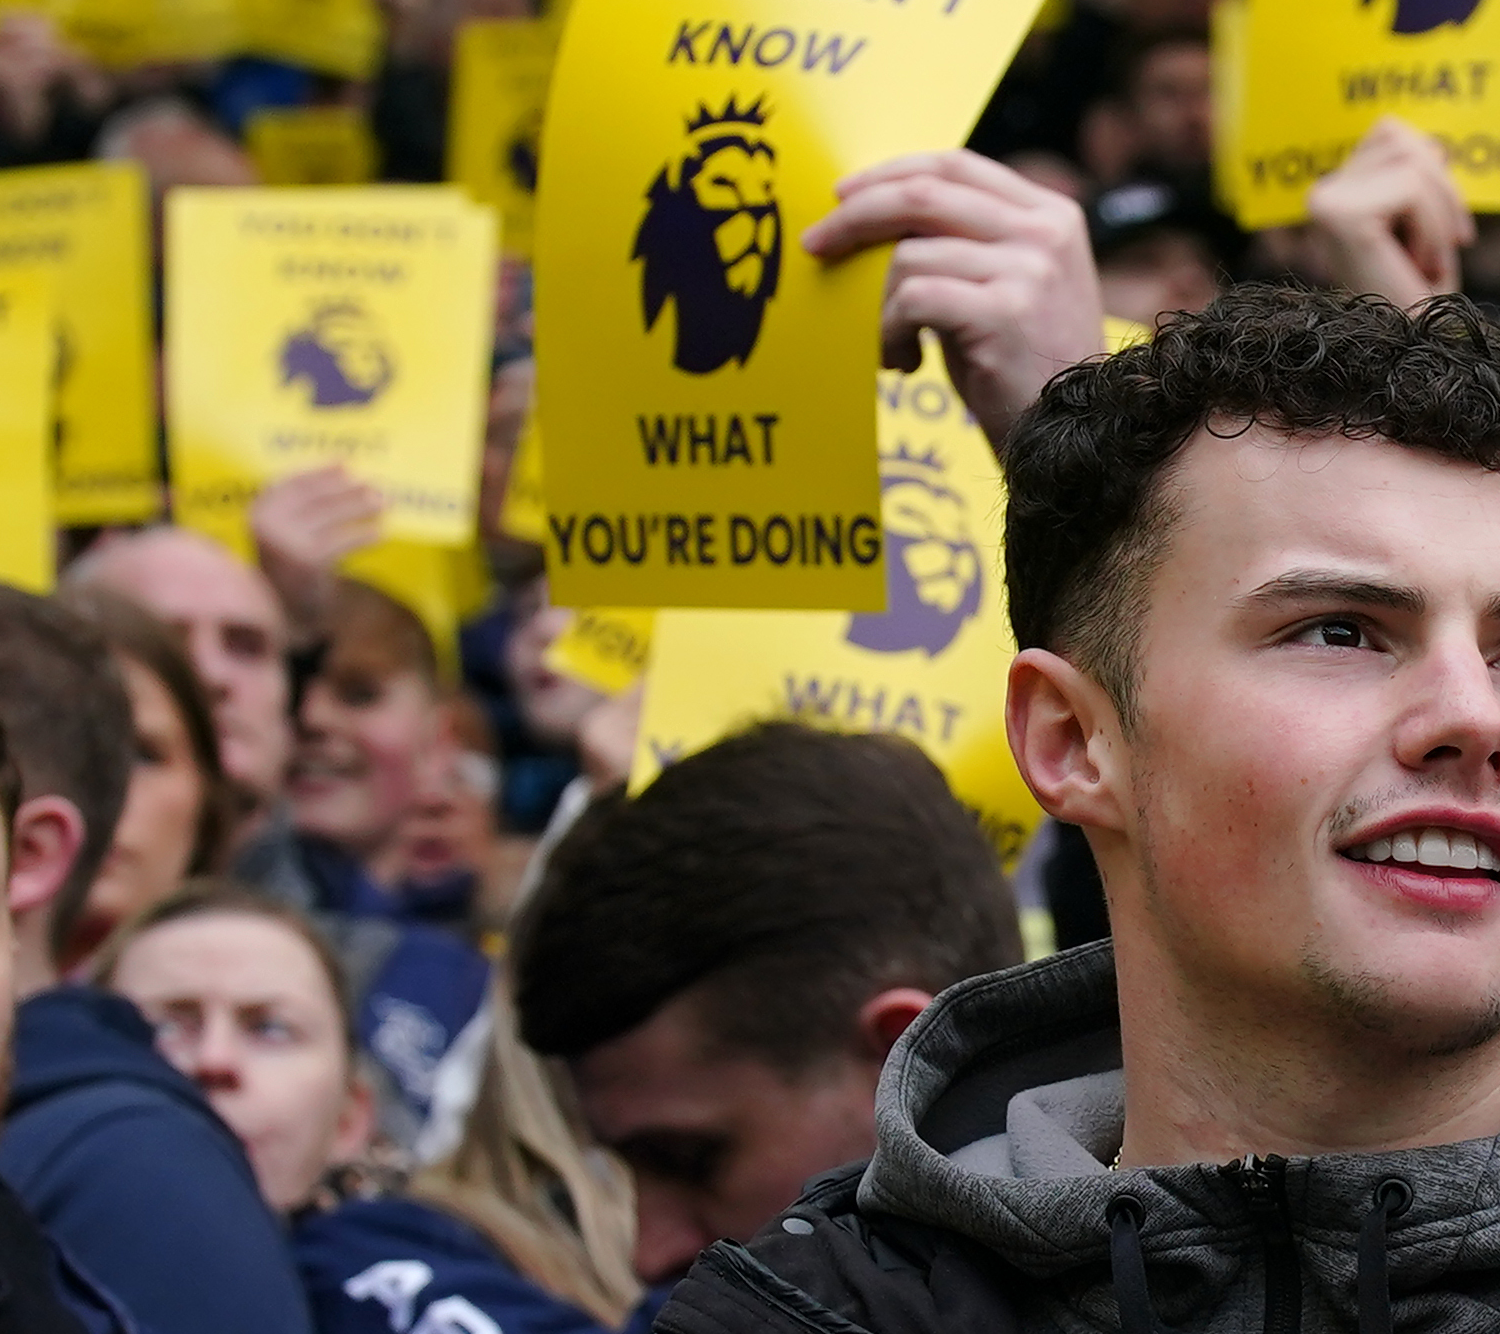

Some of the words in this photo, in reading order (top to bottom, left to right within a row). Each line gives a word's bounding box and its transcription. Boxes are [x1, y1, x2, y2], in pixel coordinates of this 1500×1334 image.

[668, 20, 867, 76] KNOW
[1341, 65, 1486, 105] WHAT
[639, 415, 778, 465] WHAT
[548, 514, 717, 567] YOU'RE
[730, 515, 881, 566] DOING
[782, 674, 963, 745] WHAT
